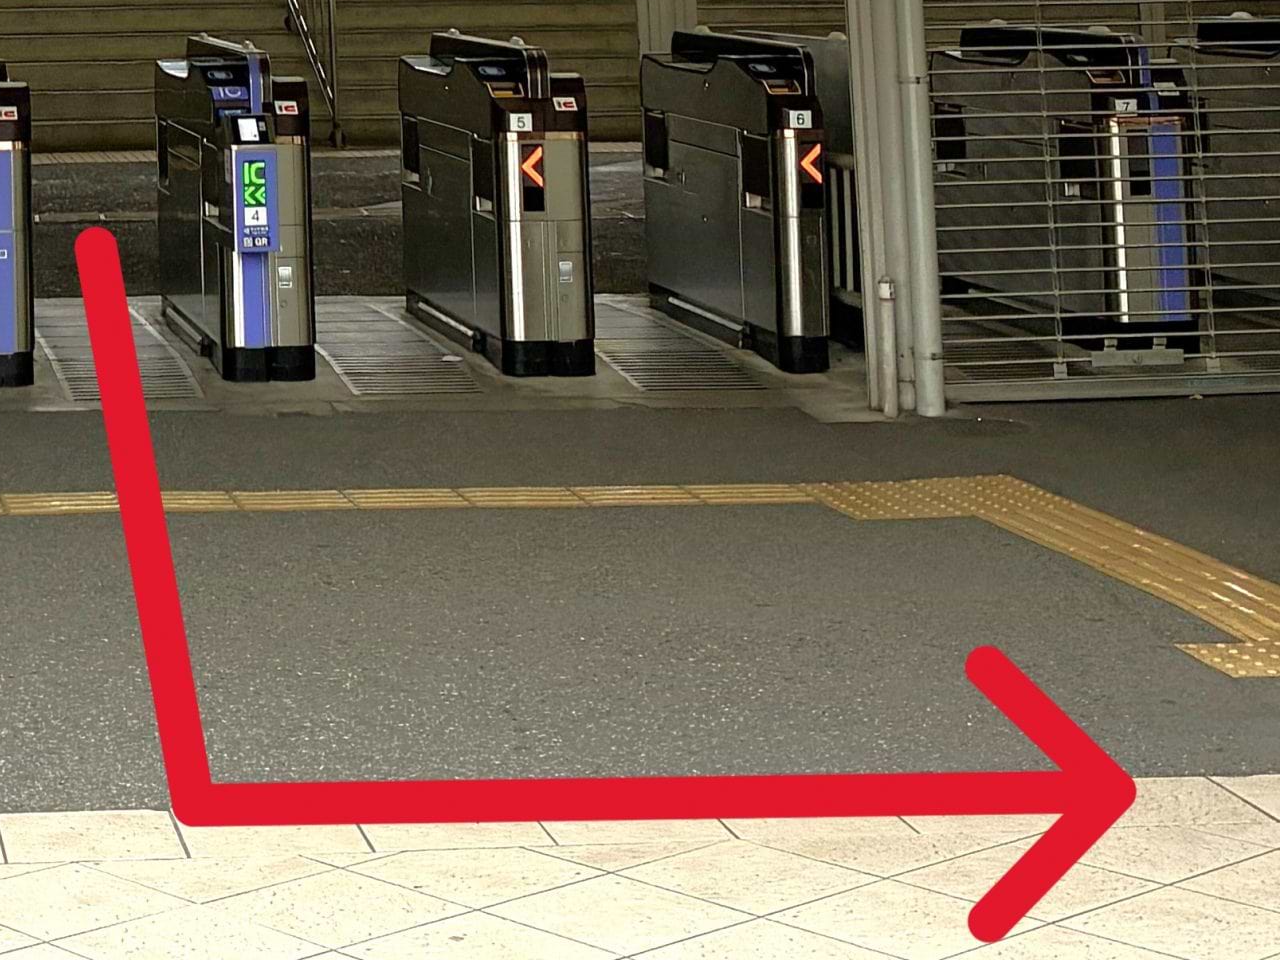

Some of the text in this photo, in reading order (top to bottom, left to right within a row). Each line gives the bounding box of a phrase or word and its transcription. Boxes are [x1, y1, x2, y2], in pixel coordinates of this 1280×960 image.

[1122, 101, 1130, 111] 7
[517, 116, 526, 129] 5
[796, 113, 805, 125] 6
[243, 162, 265, 184] IC
[251, 209, 260, 221] 4
